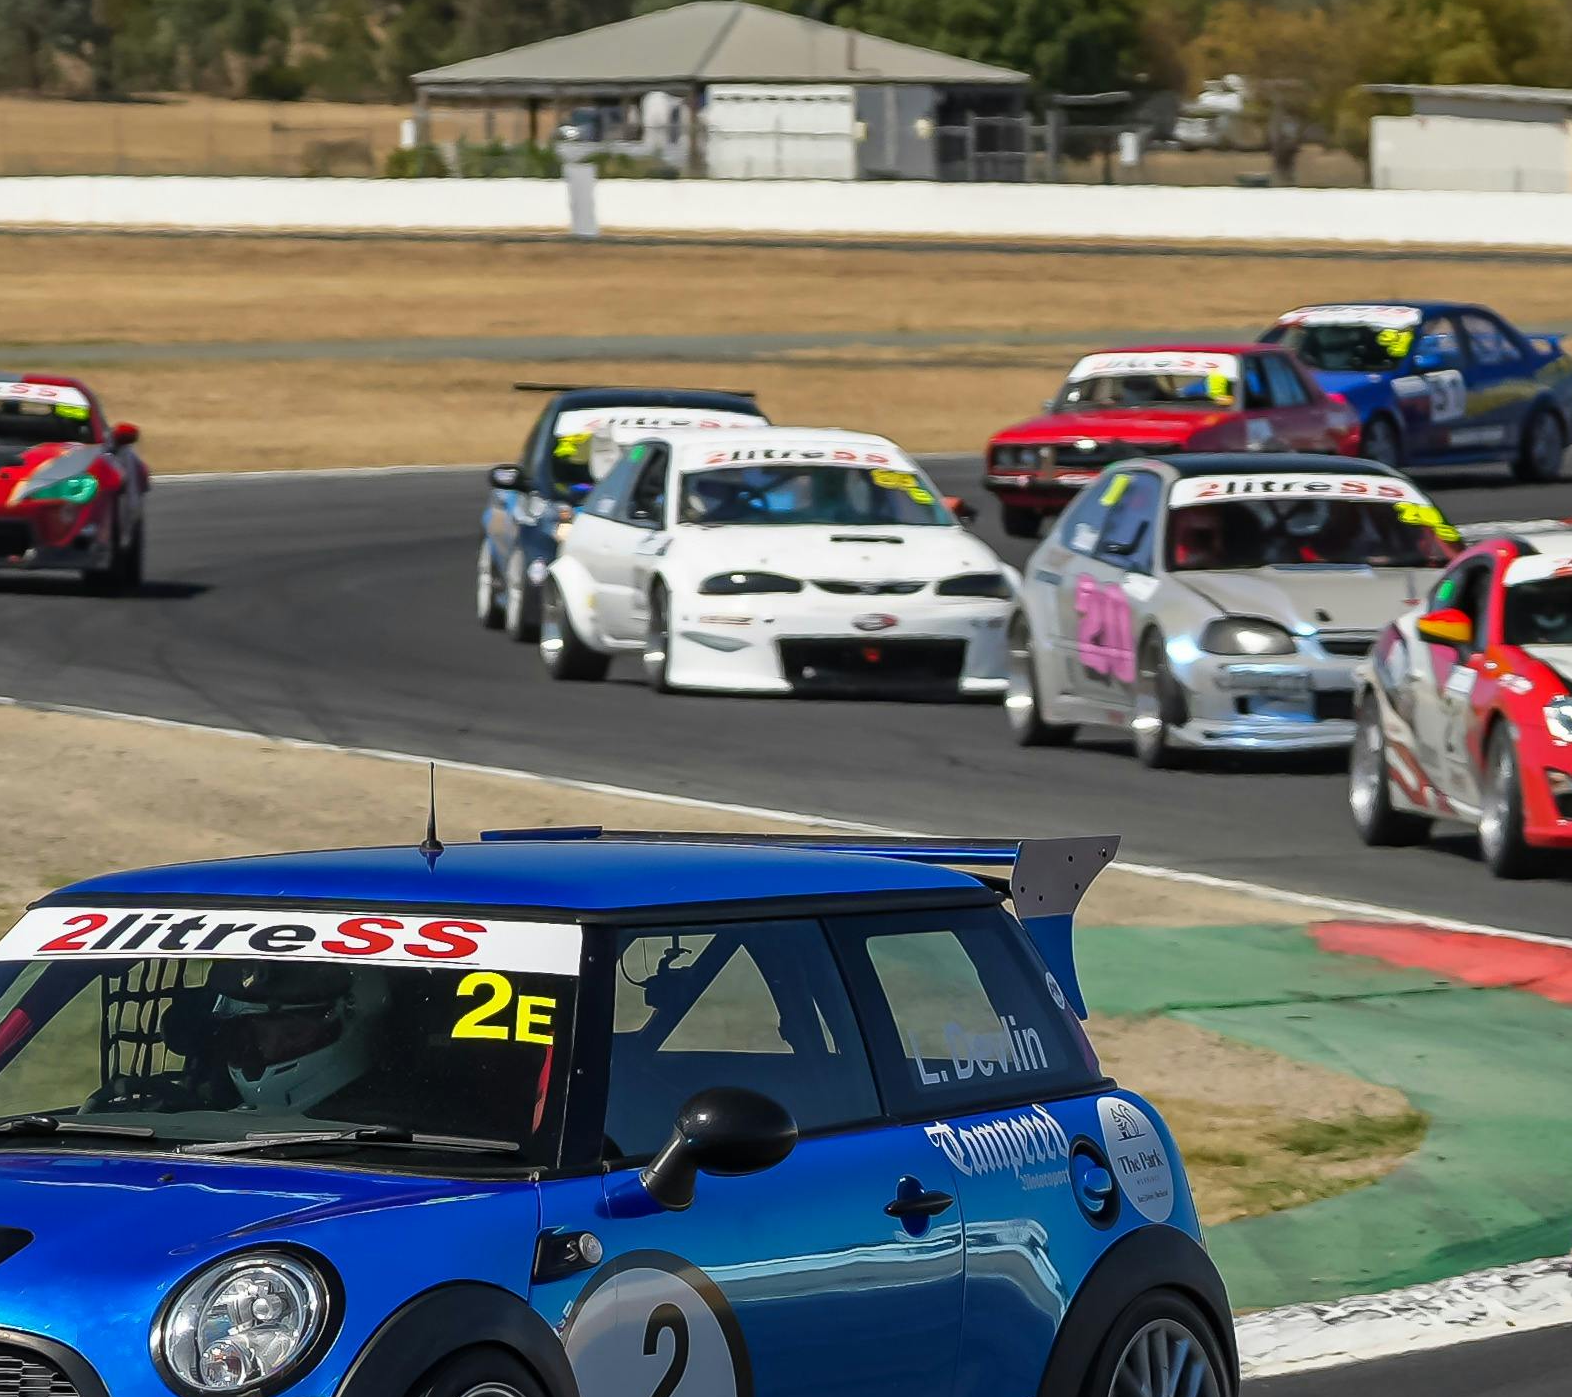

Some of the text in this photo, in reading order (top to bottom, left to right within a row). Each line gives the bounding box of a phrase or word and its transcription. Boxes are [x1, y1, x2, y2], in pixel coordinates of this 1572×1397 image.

[37, 913, 488, 961] 2litreSS
[908, 1014, 1048, 1085] L. Devlin
[924, 1103, 1069, 1178] Tempered
[1117, 1148, 1164, 1175] The Park
